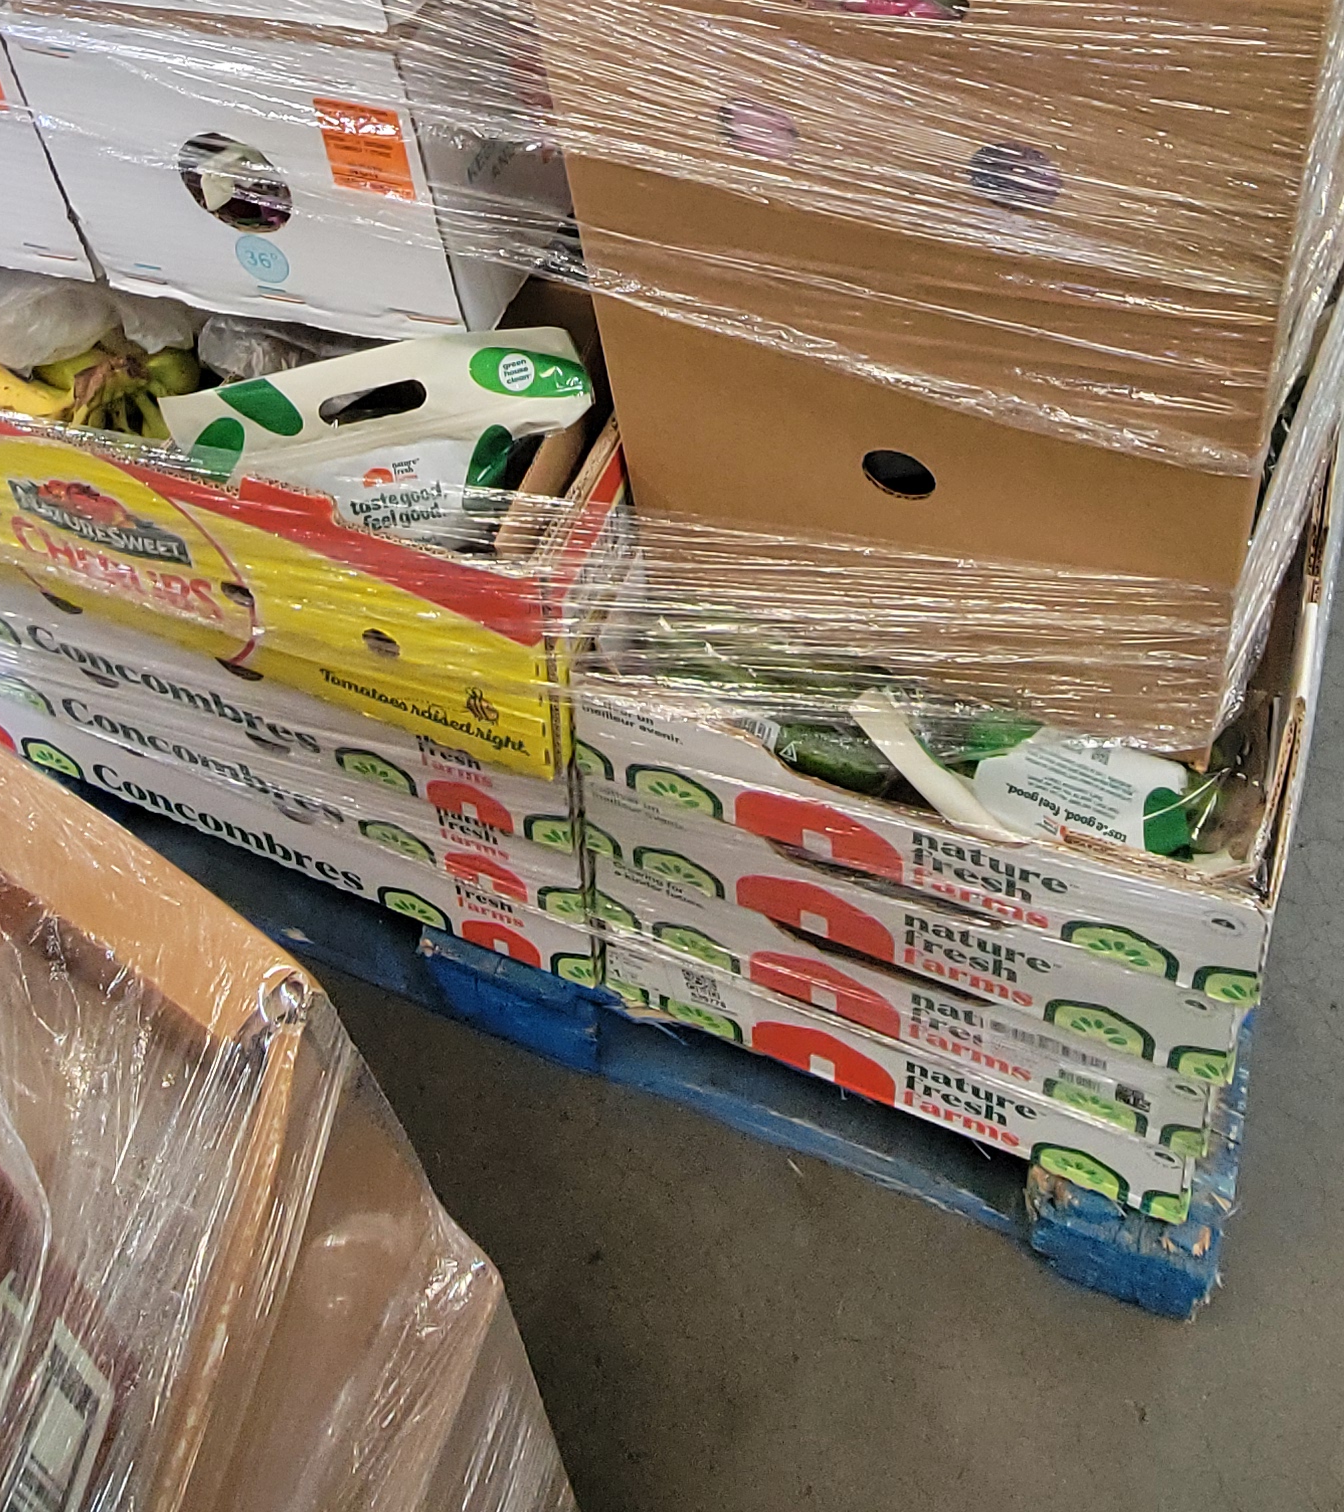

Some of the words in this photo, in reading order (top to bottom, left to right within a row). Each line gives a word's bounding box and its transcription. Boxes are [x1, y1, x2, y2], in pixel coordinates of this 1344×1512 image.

[245, 250, 279, 269] 36°
[350, 492, 399, 516] taste
[362, 508, 398, 531] feel
[26, 624, 321, 754] Concombres
[319, 667, 409, 712] Tomatoes
[409, 702, 475, 736] raised
[61, 697, 345, 823] Concombres
[417, 740, 482, 771] fresh
[1006, 782, 1040, 802] good.
[1038, 797, 1061, 817] feel
[92, 763, 364, 891] Concombres
[438, 813, 499, 846] fresh
[440, 827, 511, 861] farms
[911, 847, 1033, 904] fresh
[912, 831, 1068, 894] nature
[455, 882, 514, 914] fresh
[457, 895, 525, 928] farms
[910, 866, 1049, 929] farms
[904, 913, 1052, 974] nature
[904, 929, 1018, 984] fresh
[903, 947, 1034, 1008] farms
[908, 1022, 1033, 1083] farms
[903, 1088, 1020, 1148] farms
[905, 1060, 1038, 1120] nature
[905, 1074, 1009, 1127] fresh
